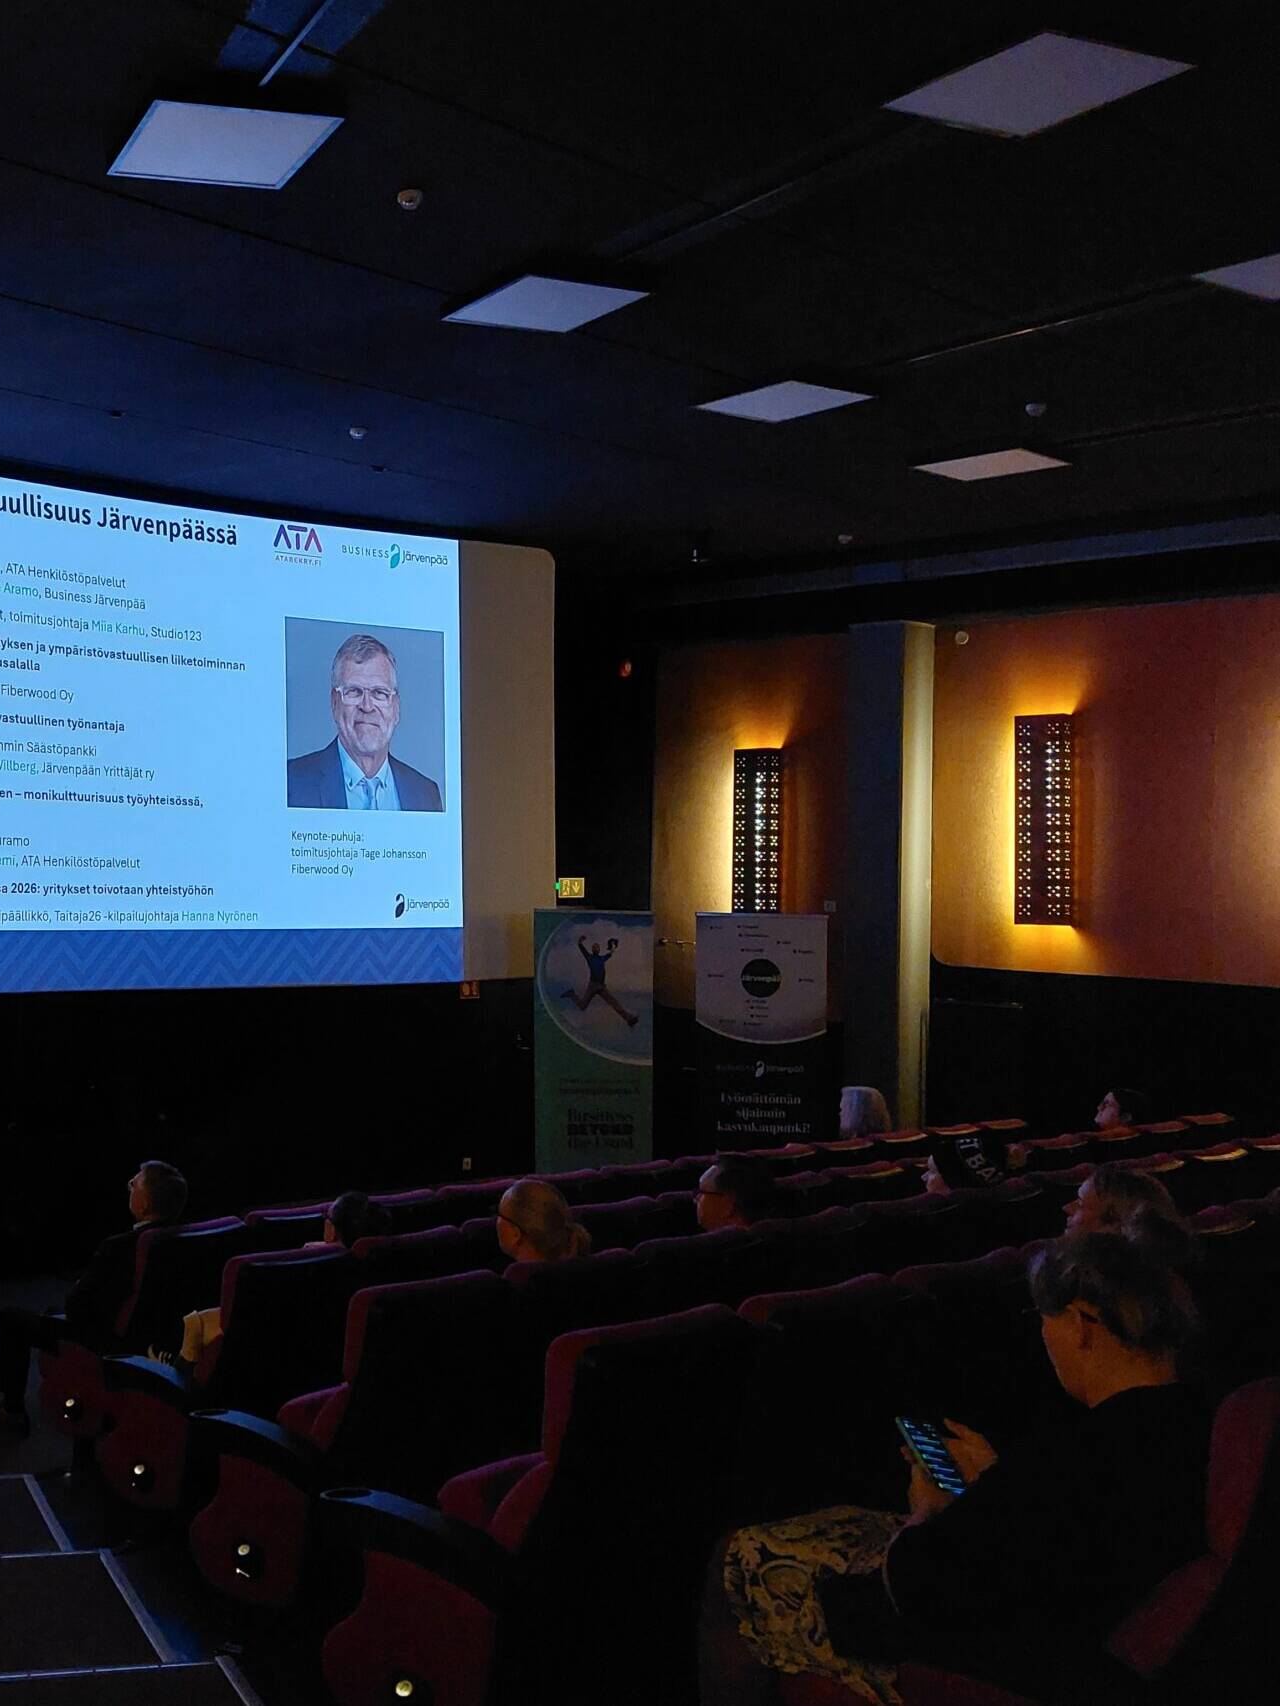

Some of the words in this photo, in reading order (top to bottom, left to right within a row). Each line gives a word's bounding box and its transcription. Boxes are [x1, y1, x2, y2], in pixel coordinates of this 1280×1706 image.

[97, 506, 238, 545] Järvenpäässä
[273, 524, 322, 552] ATA
[342, 544, 389, 559] BUSINESS
[401, 550, 448, 566] Järvenpää
[5, 562, 26, 576] ATA
[28, 565, 126, 588] Henkilöstöpalvelut
[3, 581, 42, 599] Aramo,
[44, 586, 91, 604] Business
[94, 593, 146, 611] Järvenpää
[9, 610, 89, 632] toimitusjohtaja
[91, 619, 113, 633] Miia
[115, 621, 149, 638] Karhu,
[151, 625, 202, 642] Studio123
[35, 640, 46, 655] ja
[48, 644, 169, 664] ympäristövastuullisen
[171, 653, 246, 671] liiketoiminnan
[0, 683, 56, 700] Fiberwood
[59, 688, 74, 704] Oy
[67, 717, 125, 734] työnantaja
[26, 741, 97, 757] Säästöpankki
[41, 761, 101, 778] Järvenpään
[103, 764, 142, 780] Yrittäjät
[144, 769, 155, 782] ry
[23, 789, 125, 804] monikulttuurisuus
[126, 793, 204, 808] työyhteisössä,
[291, 829, 364, 844] Keynote-puhuja:
[21, 854, 40, 867] ATA
[43, 855, 141, 870] Henkilöstöpalvelut
[291, 846, 359, 861] toimitusjohtaja
[360, 847, 380, 861] Tage
[382, 848, 427, 859] Johansson
[291, 863, 339, 875] Fiberwood
[341, 864, 354, 877] Oy
[11, 882, 41, 894] 2026:
[43, 882, 91, 897] yritykset
[93, 883, 143, 895] toivotaan
[145, 883, 214, 898] yhteistyöhön
[406, 898, 450, 911] Järvenpää
[54, 909, 101, 924] Taitaja26
[103, 909, 179, 924] -kilpailujohtaja
[181, 910, 214, 922] Hanna
[217, 909, 258, 924] Nyrönen
